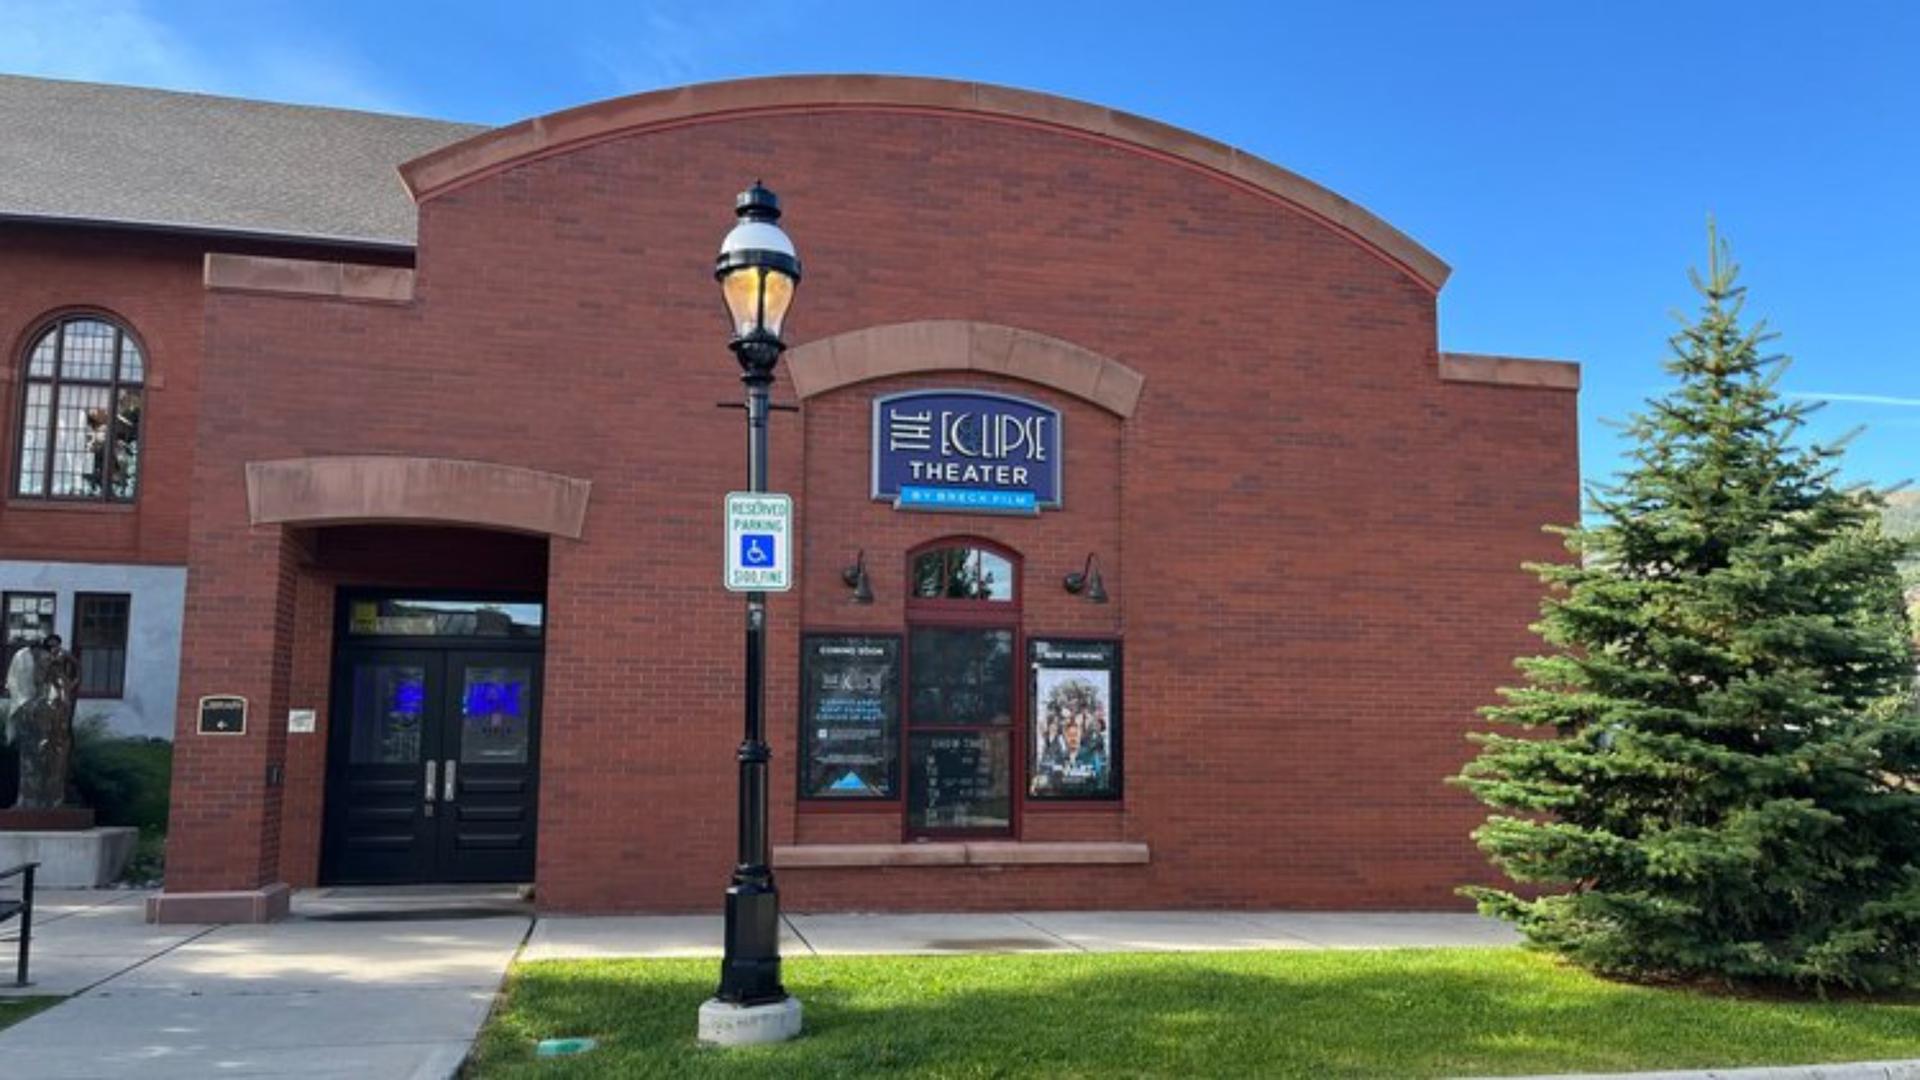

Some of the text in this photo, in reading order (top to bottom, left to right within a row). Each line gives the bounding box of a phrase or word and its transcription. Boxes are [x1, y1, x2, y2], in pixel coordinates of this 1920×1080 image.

[890, 409, 931, 451] THE
[941, 411, 1046, 461] ECLIPSE
[909, 460, 1028, 485] THEATER
[911, 490, 931, 501] BY
[992, 495, 1026, 506] FILM
[732, 502, 785, 516] RESERVED
[734, 519, 783, 532] PARKING
